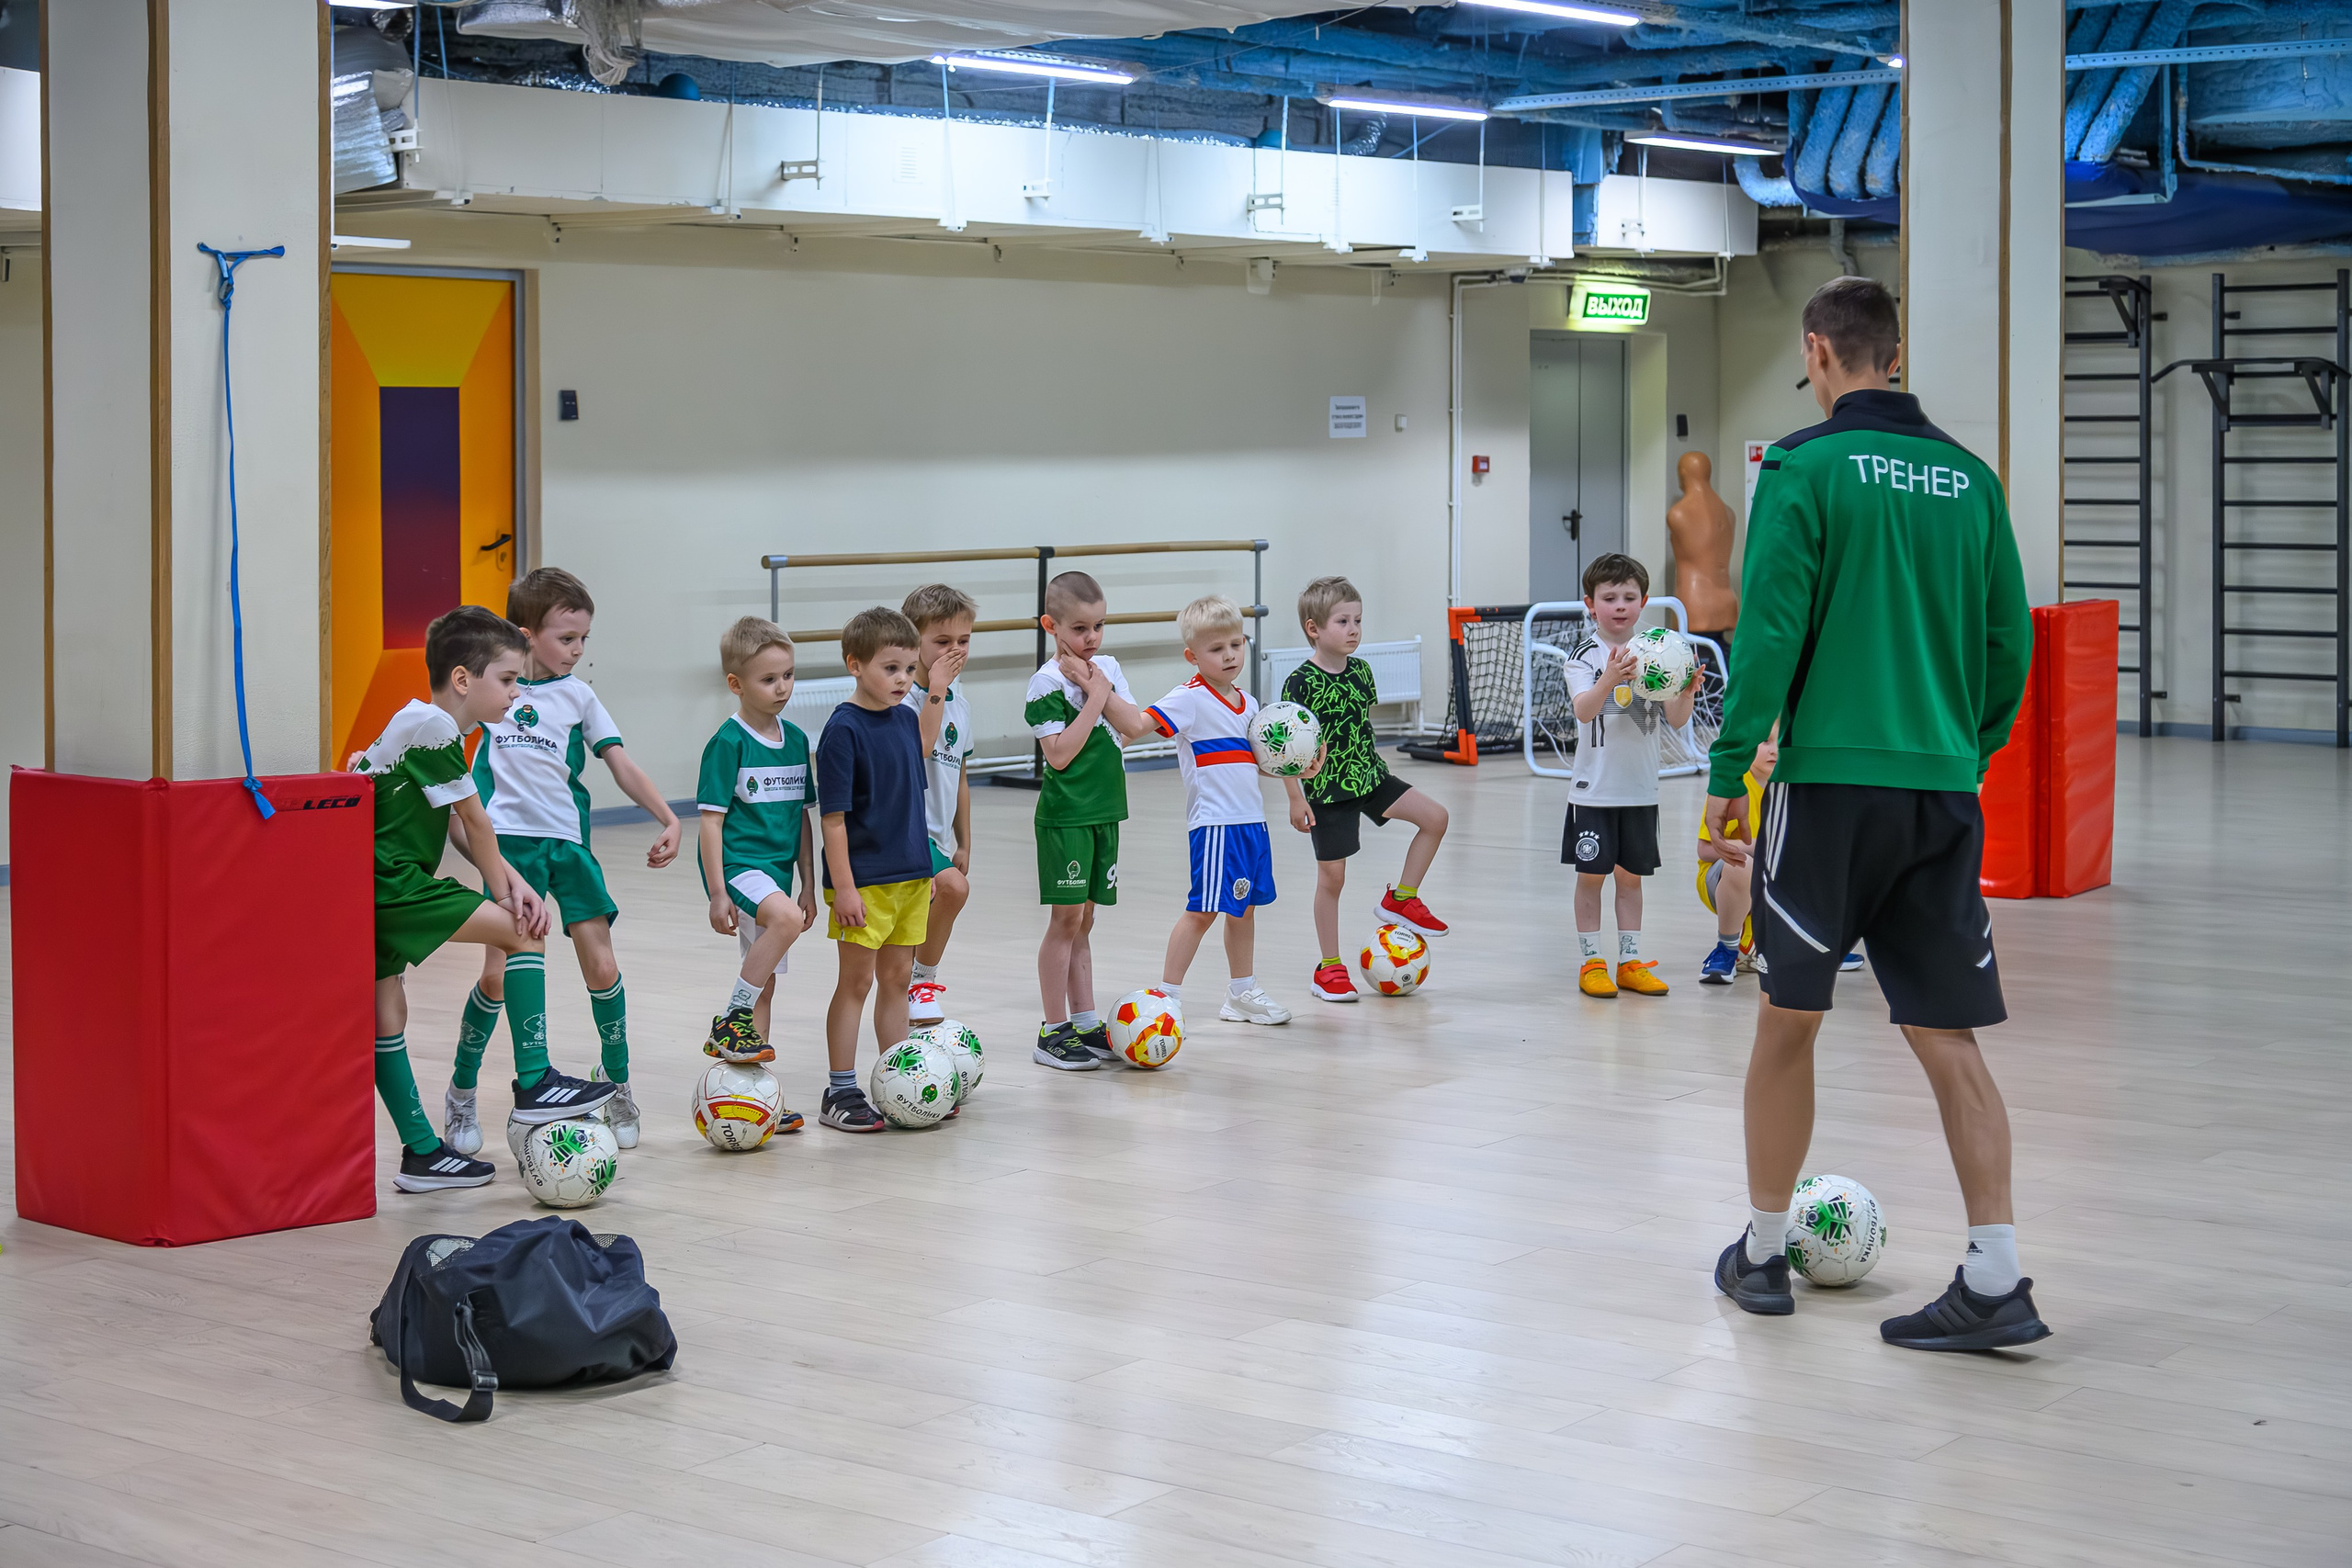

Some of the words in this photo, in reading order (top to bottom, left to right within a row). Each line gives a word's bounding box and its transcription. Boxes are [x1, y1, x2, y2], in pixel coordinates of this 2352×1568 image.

[1586, 296, 1644, 319] ВЫХОД
[1849, 455, 1970, 499] ТРЕНЕР
[495, 735, 558, 749] ФУТБОЛИКА
[302, 797, 361, 810] LECO
[1106, 863, 1118, 890] 9
[1859, 1199, 1879, 1263] ФУТБОЛИКА
